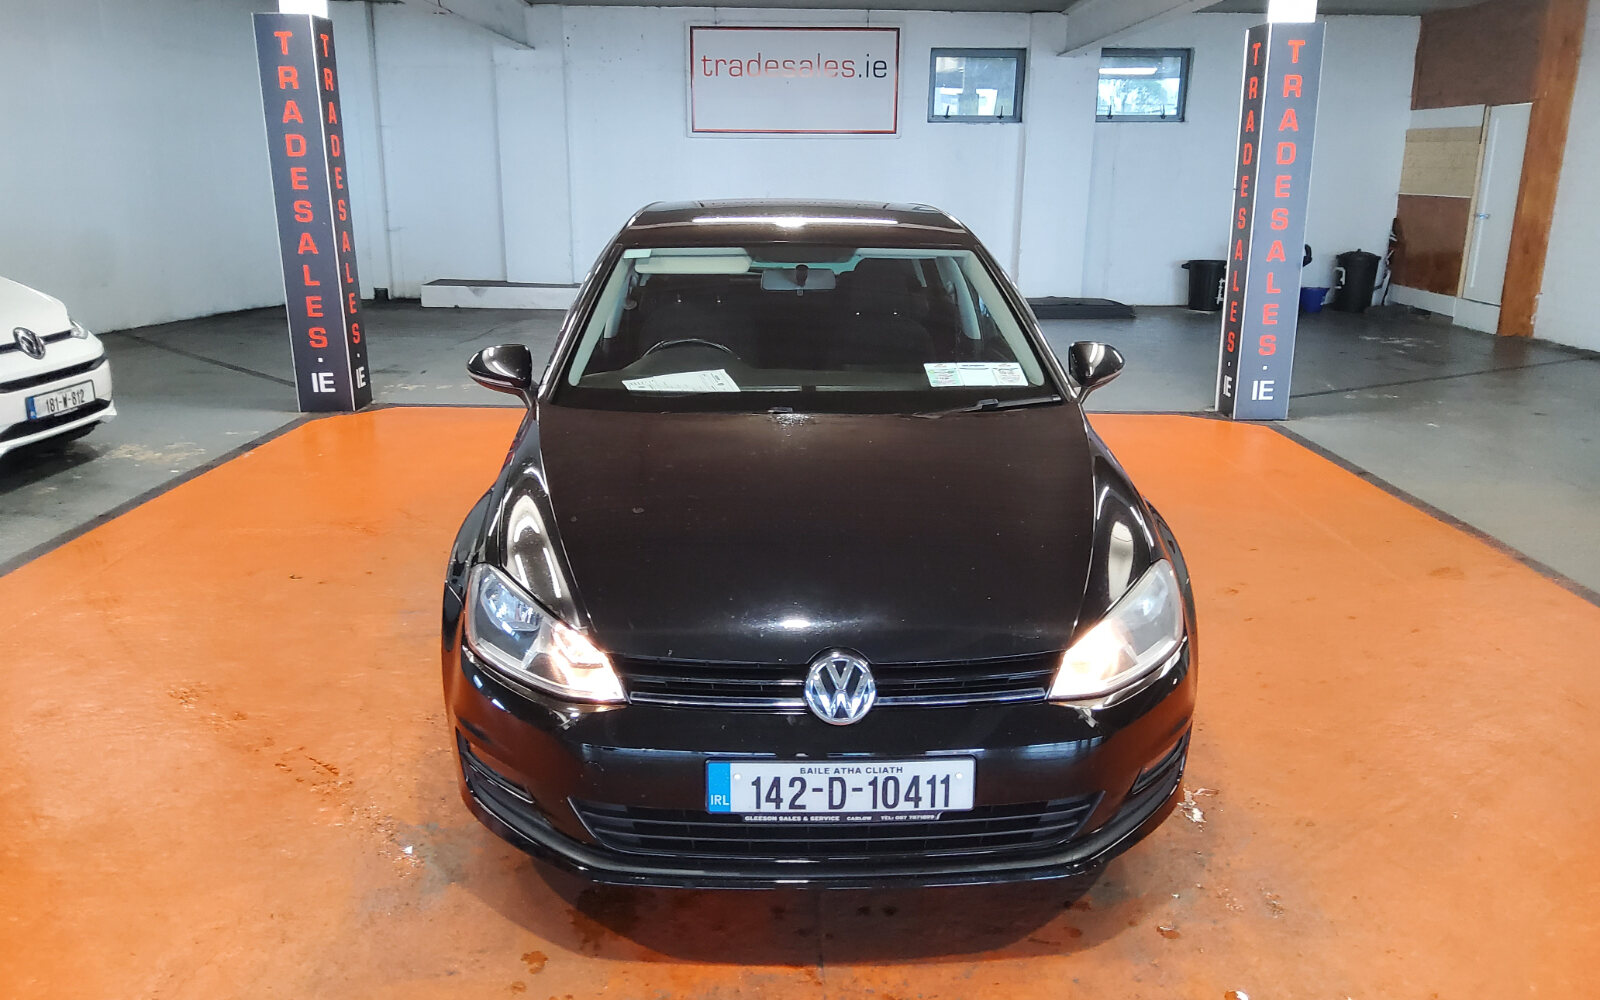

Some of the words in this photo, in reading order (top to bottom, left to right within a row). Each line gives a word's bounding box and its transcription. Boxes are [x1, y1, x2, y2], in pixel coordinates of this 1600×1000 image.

[701, 52, 888, 79] tradesales.ie
[45, 388, 85, 414] 181-W-812
[800, 767, 830, 775] BAILE
[833, 767, 862, 775] ATHA
[865, 766, 903, 774] CLIATH
[710, 794, 730, 806] IRL
[751, 774, 950, 810] 142-D-10411
